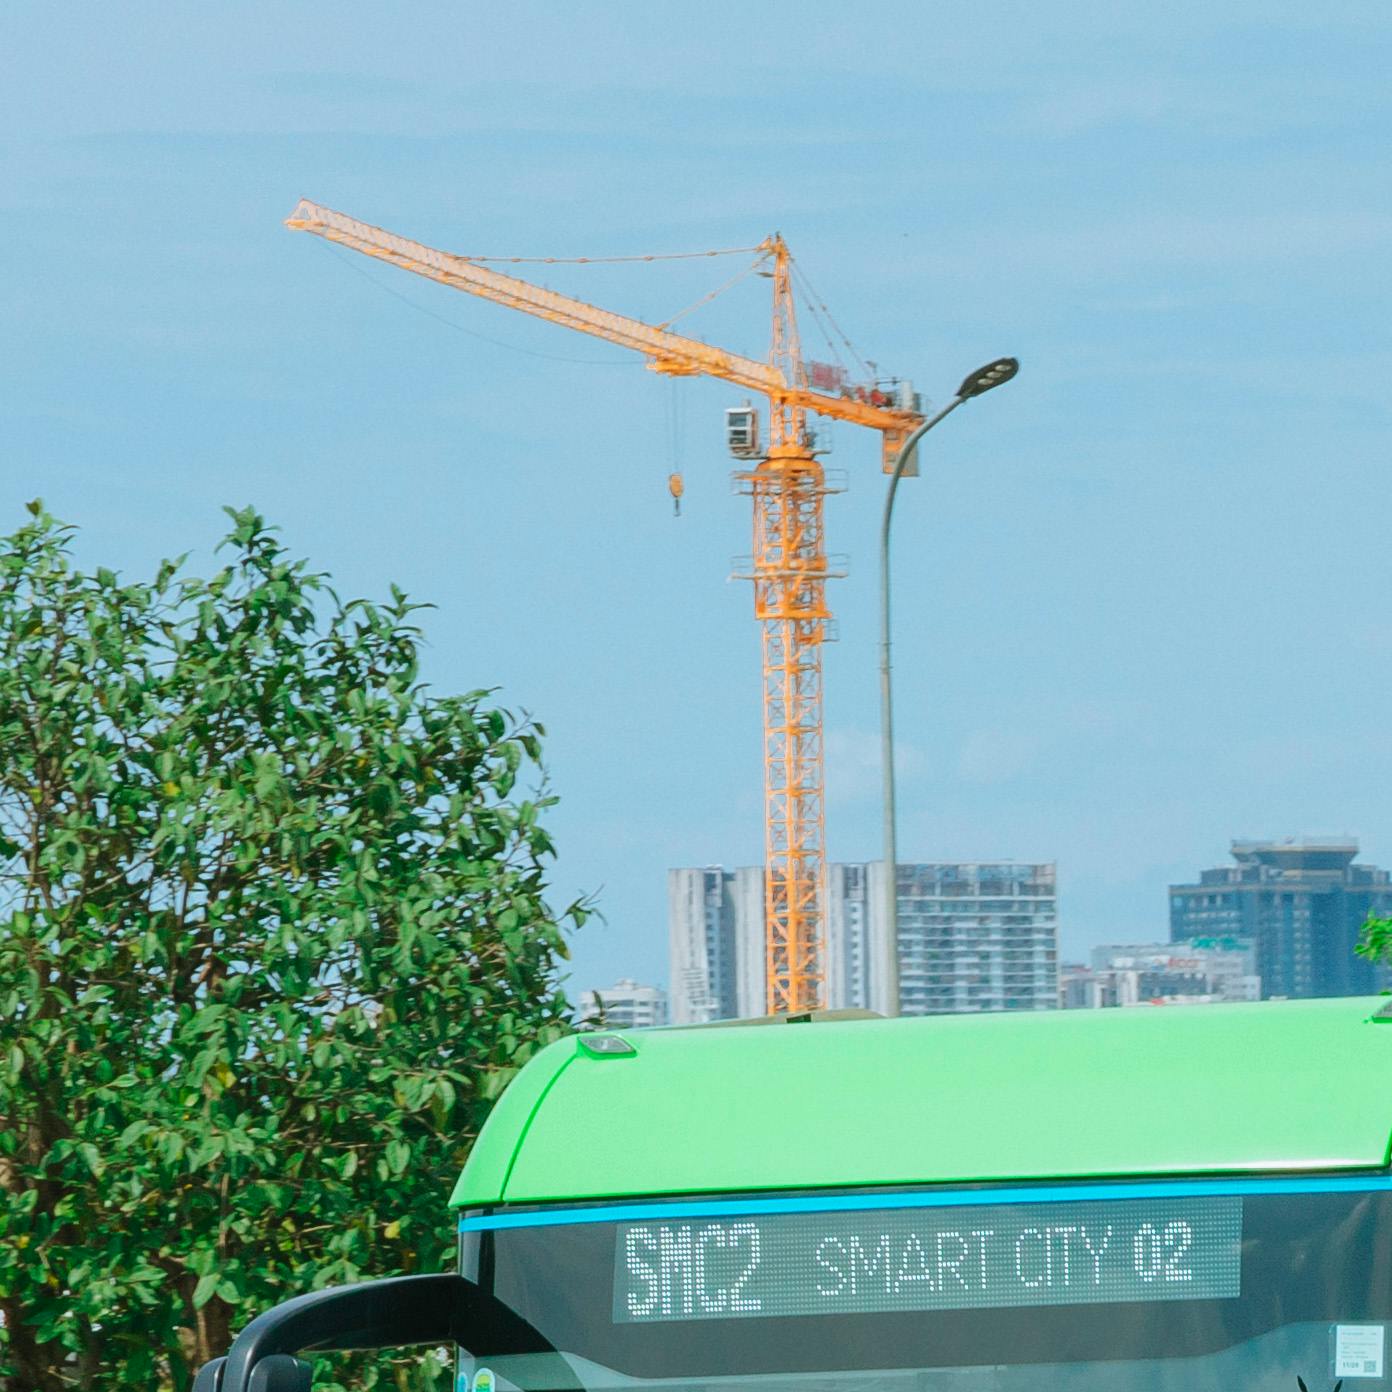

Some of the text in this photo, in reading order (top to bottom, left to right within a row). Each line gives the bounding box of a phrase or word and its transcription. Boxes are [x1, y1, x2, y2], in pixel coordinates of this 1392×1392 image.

[626, 1221, 1193, 1316] SMC2 SMART CITY 02
